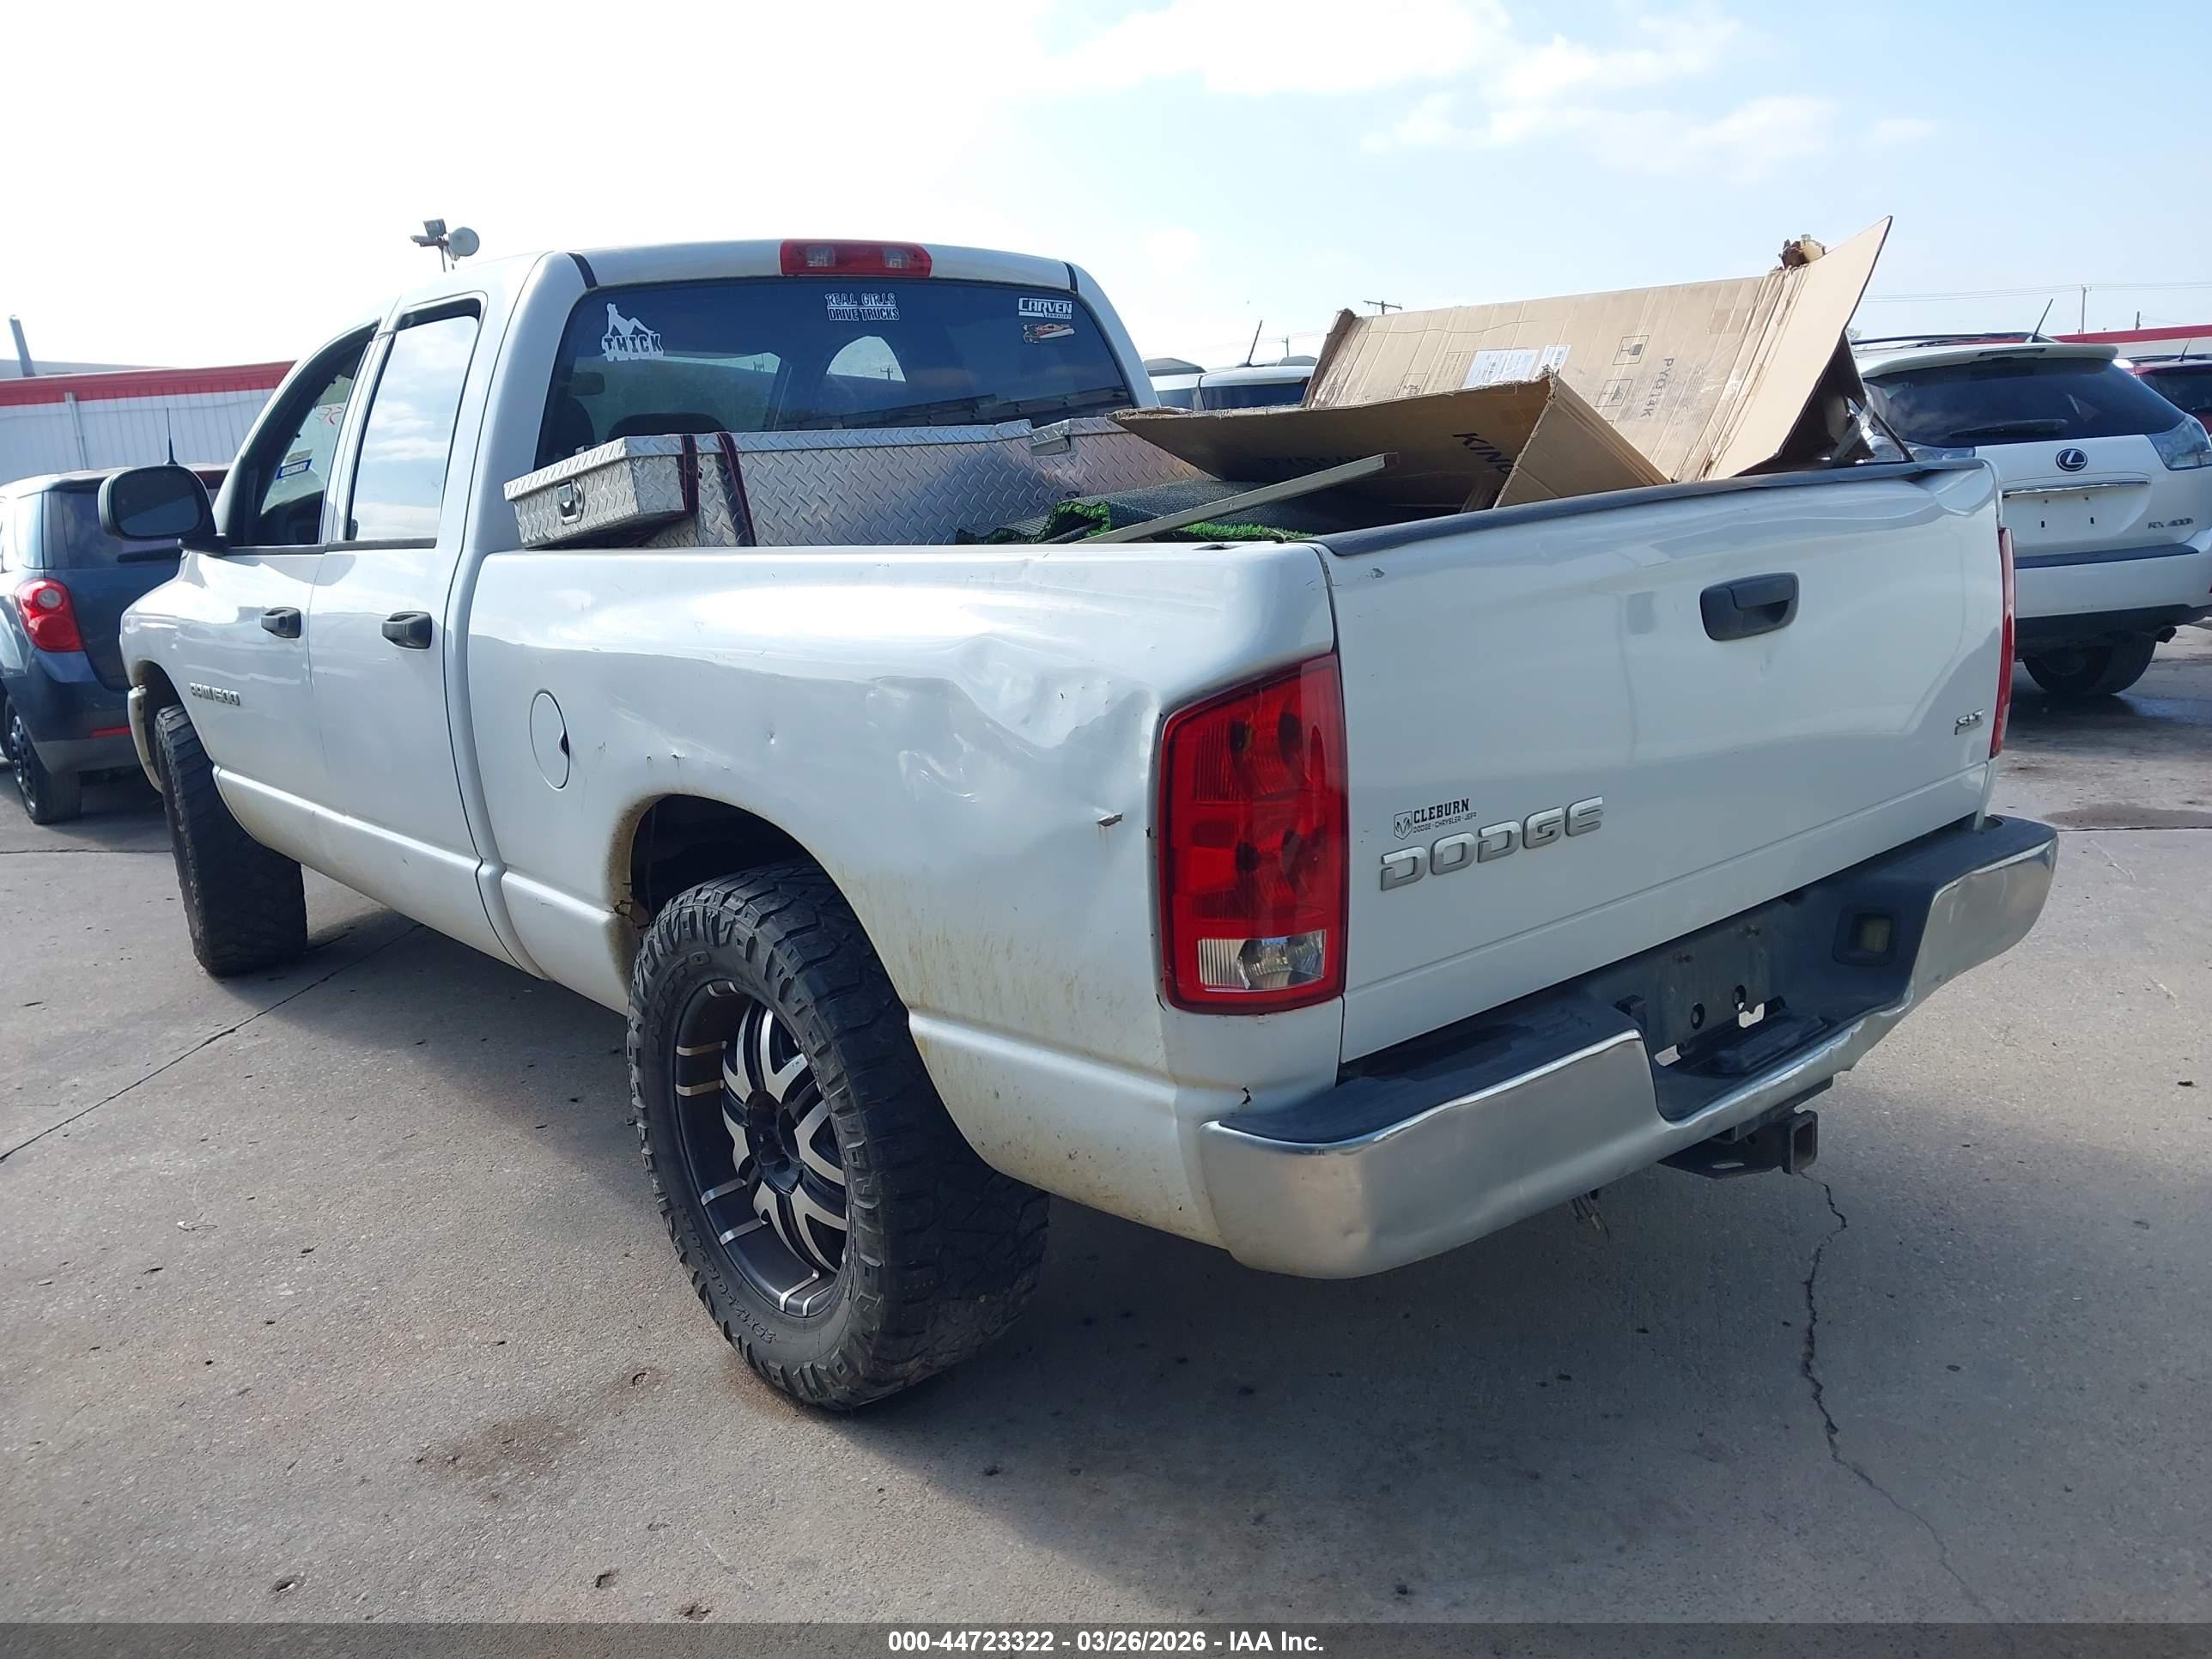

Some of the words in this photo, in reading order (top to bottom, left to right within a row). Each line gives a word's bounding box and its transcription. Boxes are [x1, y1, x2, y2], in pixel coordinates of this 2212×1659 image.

[825, 293, 858, 307] REAL
[861, 293, 896, 307] GIRLS
[1018, 298, 1073, 318] CARVEN
[828, 307, 860, 321] DRIVE
[860, 307, 900, 321] TRUCKS
[602, 333, 664, 359] THICK
[1413, 798, 1469, 823] CLEBURN
[1381, 795, 1603, 891] DODGE
